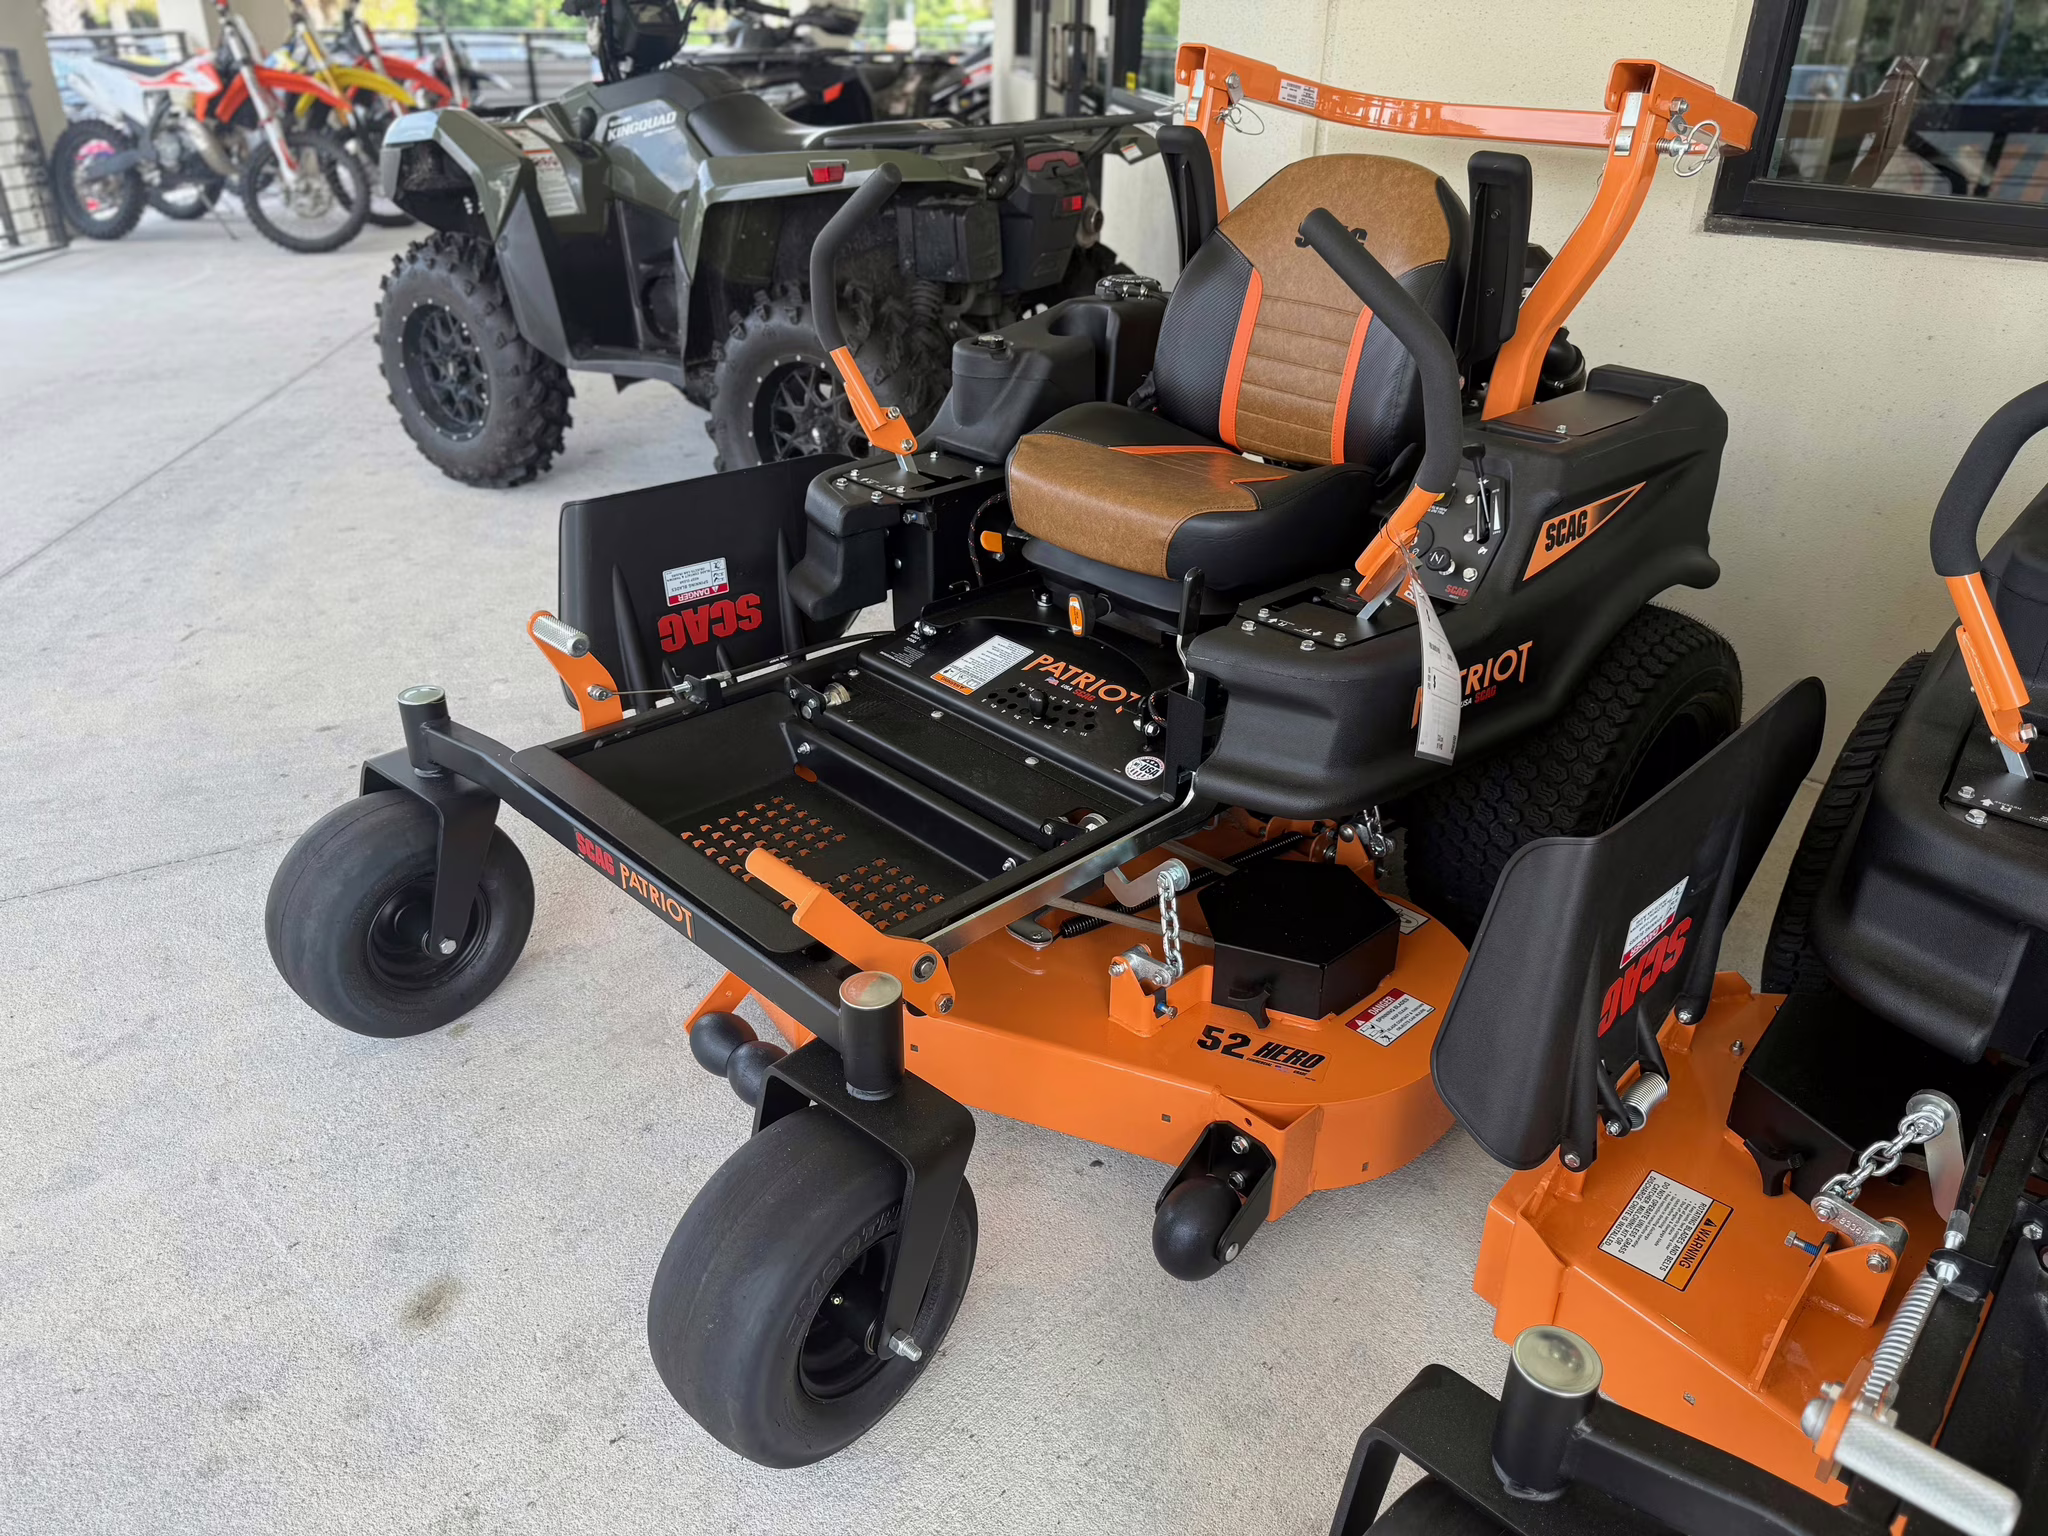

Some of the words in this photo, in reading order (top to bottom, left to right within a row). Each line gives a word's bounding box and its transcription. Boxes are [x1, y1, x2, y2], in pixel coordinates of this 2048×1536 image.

[607, 111, 677, 142] KINGQUAD
[1545, 509, 1588, 552] SCAG
[678, 588, 709, 600] DANGER
[1445, 585, 1469, 598] SCAG
[658, 593, 763, 653] SCAG
[1073, 688, 1097, 702] SCAG
[1411, 640, 1533, 730] RIOT
[1475, 685, 1497, 704] SCAG
[1139, 764, 1160, 777] USA
[576, 831, 616, 877] SCAG
[619, 862, 693, 939] PATRIOT
[1597, 917, 1693, 1039] SCAG
[1368, 996, 1394, 1014] DANGER
[1375, 1008, 1394, 1022] SPINNING
[1393, 998, 1408, 1009] BLADES
[1197, 1024, 1252, 1059] 52
[1252, 1041, 1326, 1069] HERO
[1635, 1175, 1655, 1200] DISCHARGE
[1641, 1183, 1659, 1203] CATCHER,
[1655, 1188, 1665, 1199] NOT
[1625, 1200, 1638, 1215] CHUTE
[1625, 1205, 1645, 1228] MULCHING
[1641, 1199, 1658, 1219] OPERATE
[1688, 1202, 1706, 1225] ROTATING
[1604, 1221, 1624, 1245] INSTALLED
[1620, 1228, 1629, 1237] KIT
[1629, 1219, 1644, 1237] UNLESS
[1676, 1225, 1692, 1244] BLADES
[1618, 1237, 1632, 1253] GRASS
[1669, 1243, 1680, 1255] AND
[1679, 1229, 1710, 1268] WARNING
[1659, 1255, 1673, 1271] BELTS
